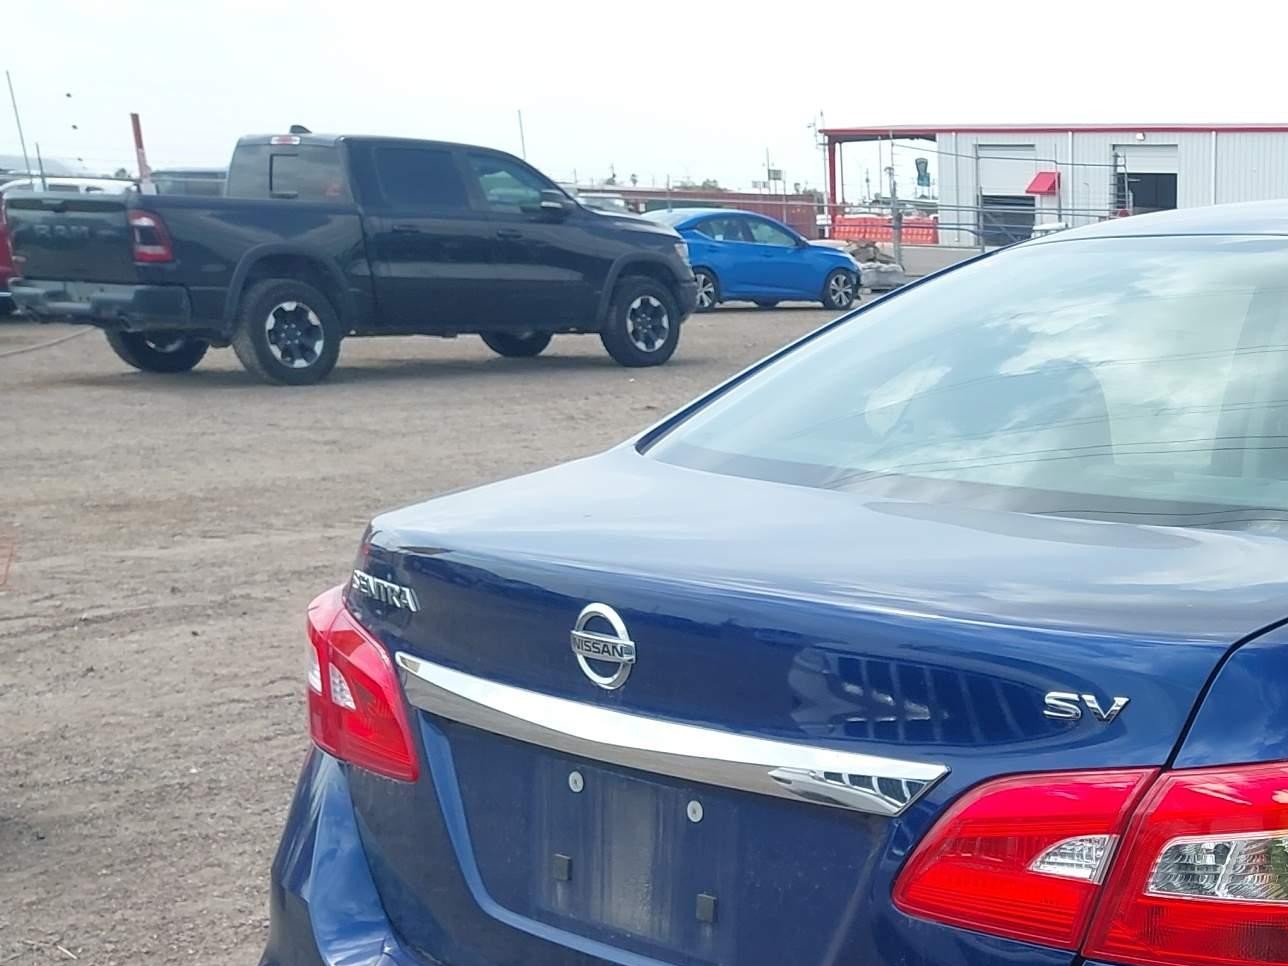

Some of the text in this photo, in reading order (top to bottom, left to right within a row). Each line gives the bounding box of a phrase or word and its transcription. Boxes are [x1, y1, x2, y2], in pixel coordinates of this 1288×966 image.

[352, 569, 419, 612] SENTRA
[575, 637, 624, 657] NISSAN
[1043, 691, 1130, 722] SV
